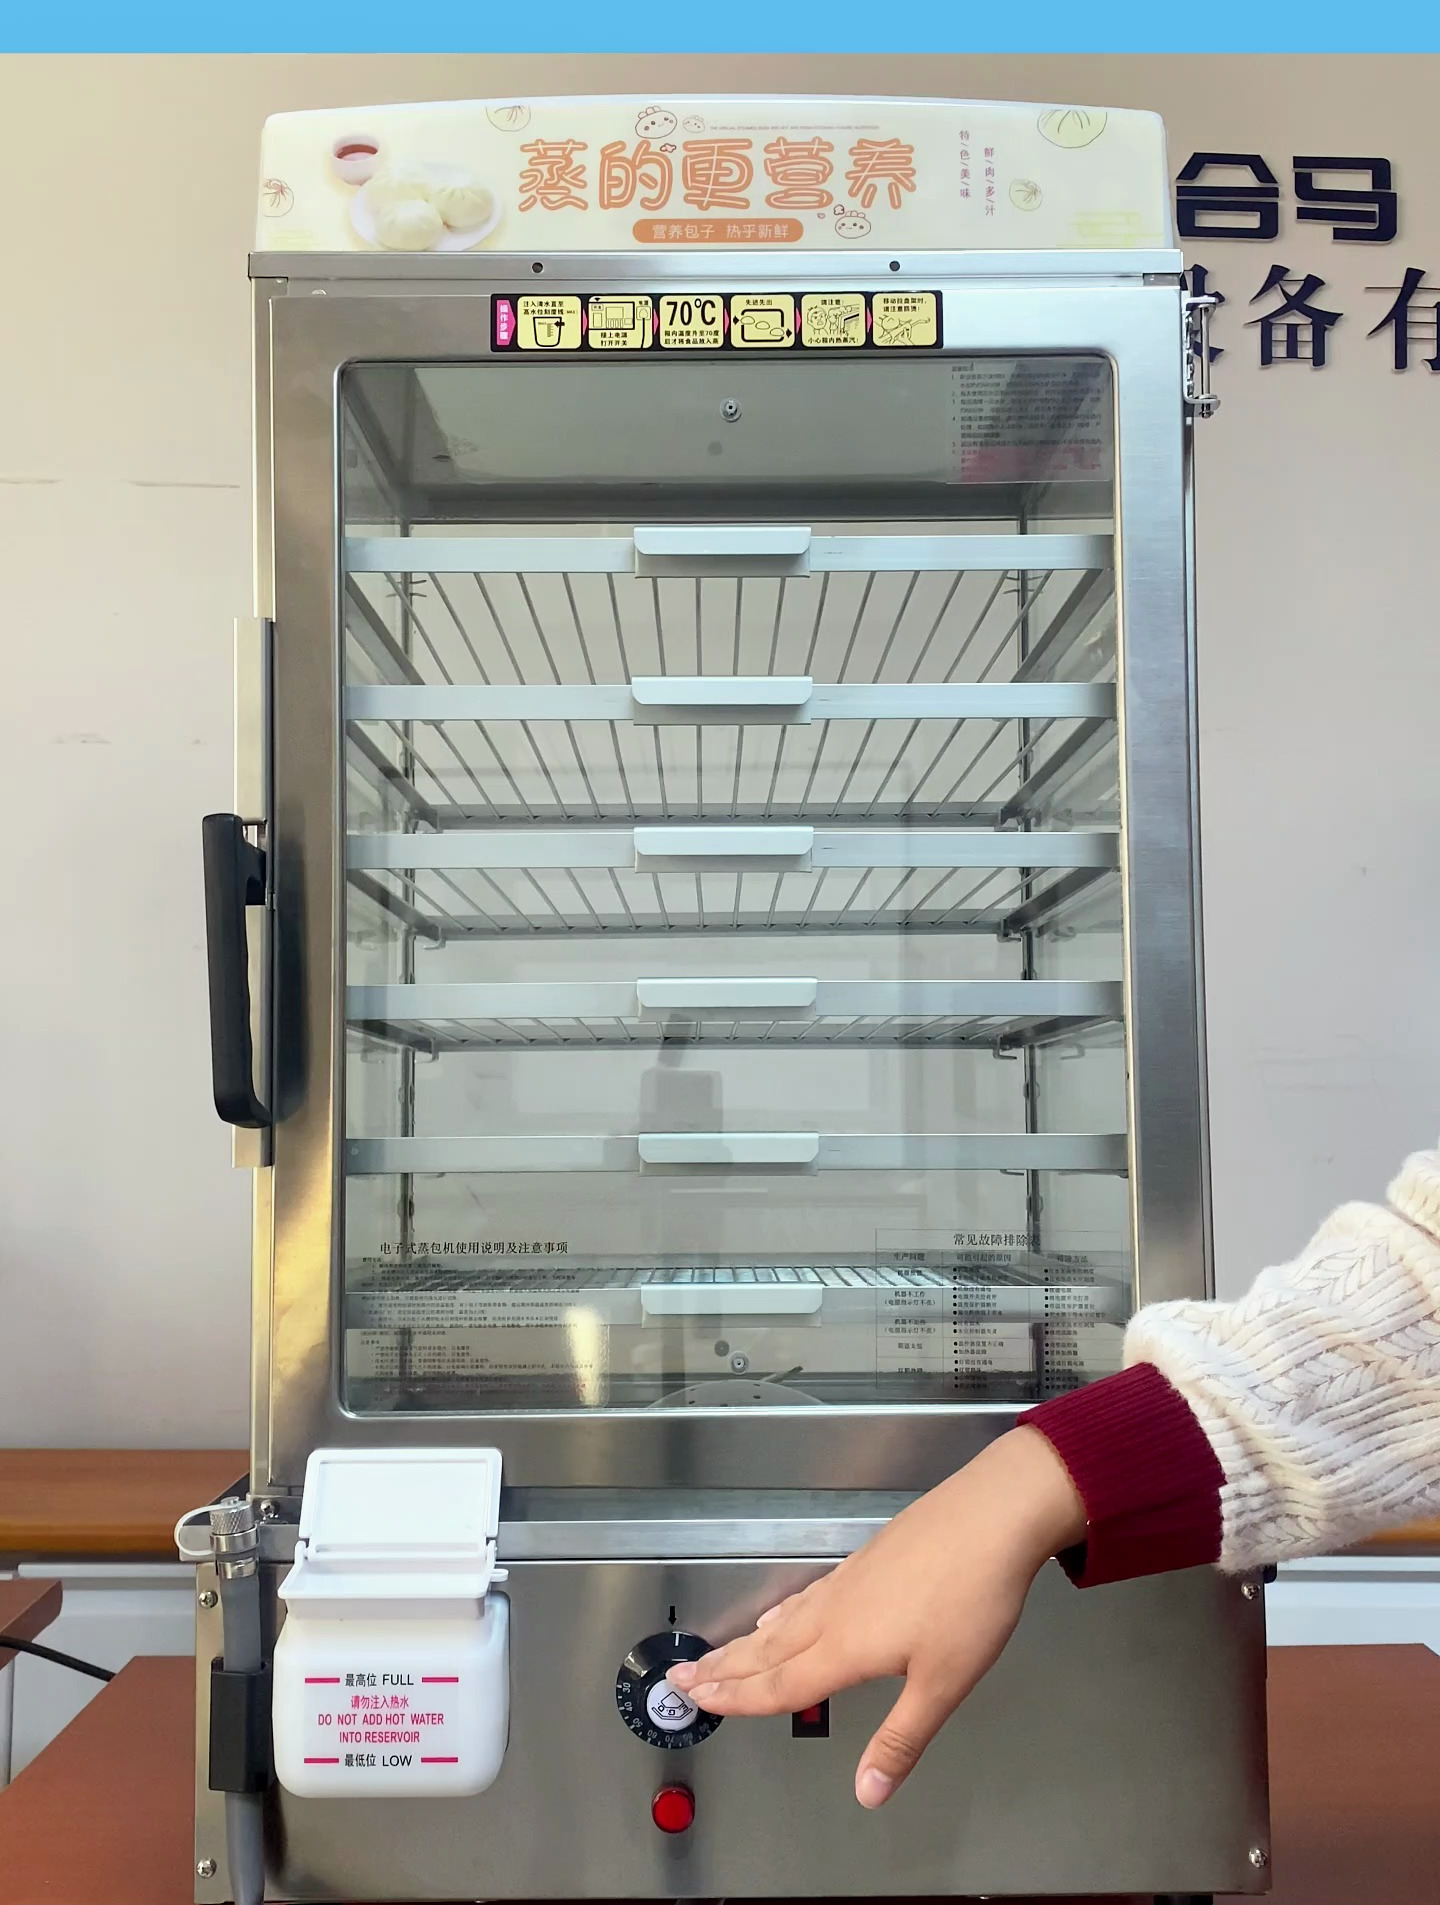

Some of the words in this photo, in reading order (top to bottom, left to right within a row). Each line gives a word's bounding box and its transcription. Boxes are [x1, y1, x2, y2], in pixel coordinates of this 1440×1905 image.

[519, 136, 917, 212] 蒸的更营养
[652, 223, 715, 240] 营养包子
[725, 223, 790, 240] 热乎新鲜
[380, 1241, 569, 1255] 电子式蒸包机使用说明及注意事项
[345, 1673, 377, 1687] 最高位
[382, 1673, 414, 1686] FULL
[622, 1682, 631, 1693] 30
[351, 1695, 409, 1710] 请勿注入热水
[624, 1701, 633, 1712] 40
[318, 1713, 332, 1726] DO
[337, 1713, 357, 1726] NOT
[362, 1713, 383, 1726] ADD
[385, 1713, 405, 1726] HOT
[411, 1713, 444, 1725] WATER
[632, 1717, 643, 1728] 50
[339, 1731, 362, 1744] INTO
[365, 1731, 420, 1743] RESERVOIR
[647, 1729, 658, 1739] 60
[665, 1734, 675, 1743] 70
[345, 1753, 377, 1767] 最低位
[382, 1754, 412, 1767] LOW
